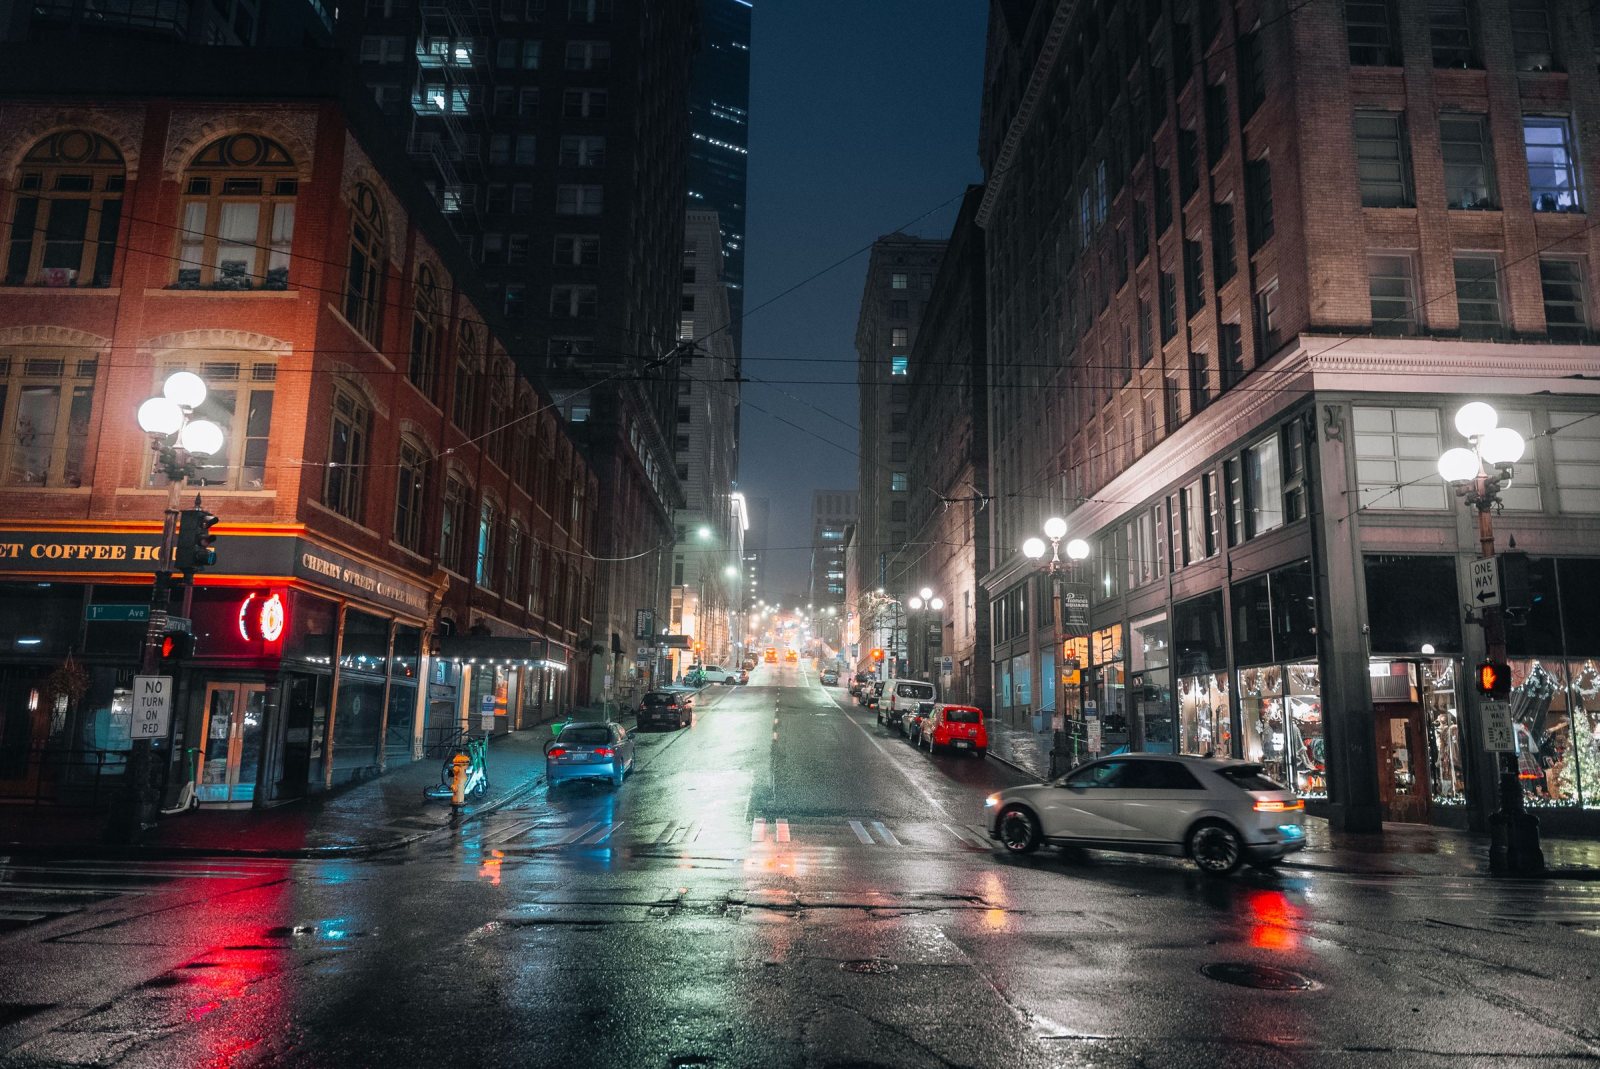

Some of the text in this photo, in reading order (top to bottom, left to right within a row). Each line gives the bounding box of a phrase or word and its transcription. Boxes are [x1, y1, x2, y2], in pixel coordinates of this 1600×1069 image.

[30, 543, 126, 560] COFFEE
[1474, 561, 1492, 575] ONE
[302, 553, 427, 610] CHERRY STREET COFFEE HOUSE
[1475, 574, 1493, 588] WAY
[128, 609, 144, 617] Ave
[145, 681, 162, 694] NO
[142, 697, 164, 707] TURN
[145, 710, 158, 720] ON
[142, 723, 159, 734] RED
